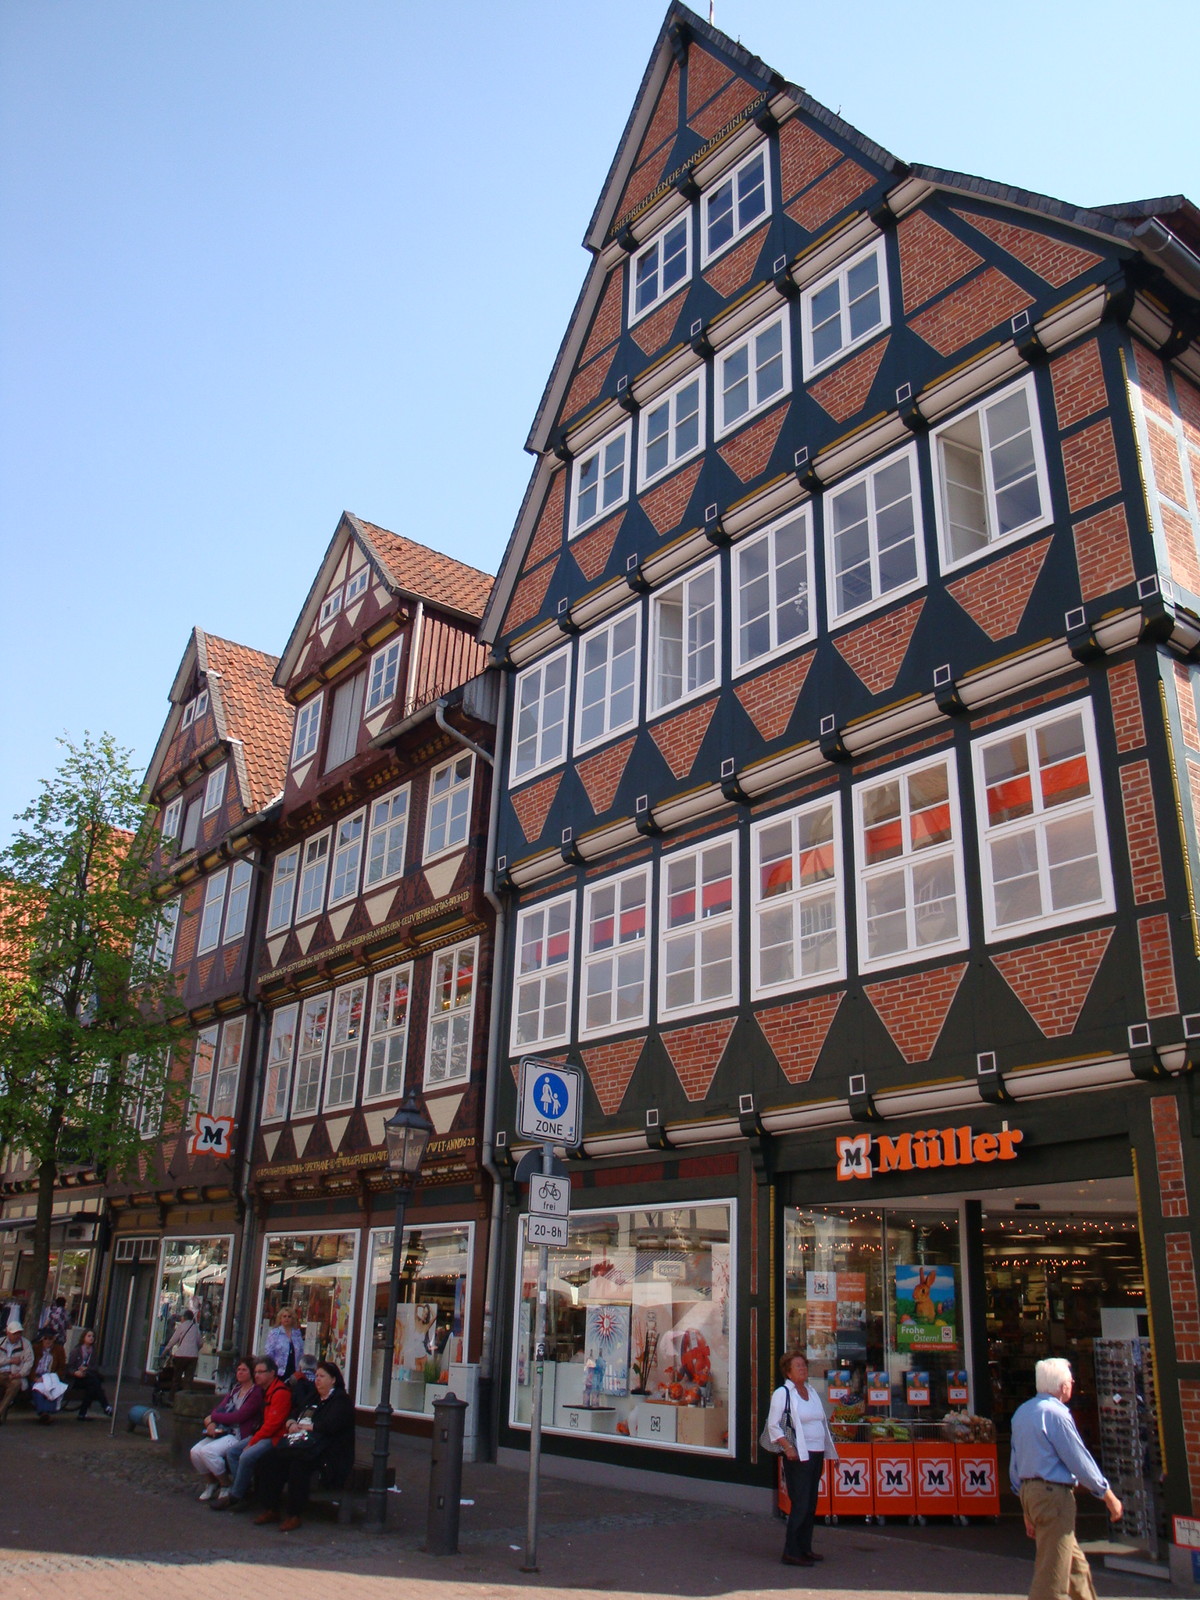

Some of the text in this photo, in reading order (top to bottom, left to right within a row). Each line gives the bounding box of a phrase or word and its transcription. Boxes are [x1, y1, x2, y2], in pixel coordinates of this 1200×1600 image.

[608, 196, 648, 236] FRIEDRICH
[681, 144, 706, 173] ANNO
[708, 113, 742, 148] DOMINI
[744, 93, 767, 117] 1960
[202, 1126, 224, 1145] M
[536, 1119, 563, 1136] ZONE
[845, 1125, 1024, 1173] M Müller
[543, 1202, 556, 1211] frei
[534, 1224, 562, 1238] 20-8h
[817, 1283, 826, 1291] M
[901, 1325, 925, 1334] Frohe
[913, 1334, 940, 1342] Ostern!
[843, 1470, 861, 1486] M
[885, 1470, 903, 1486] M
[927, 1470, 945, 1486] M
[969, 1470, 986, 1486] M
